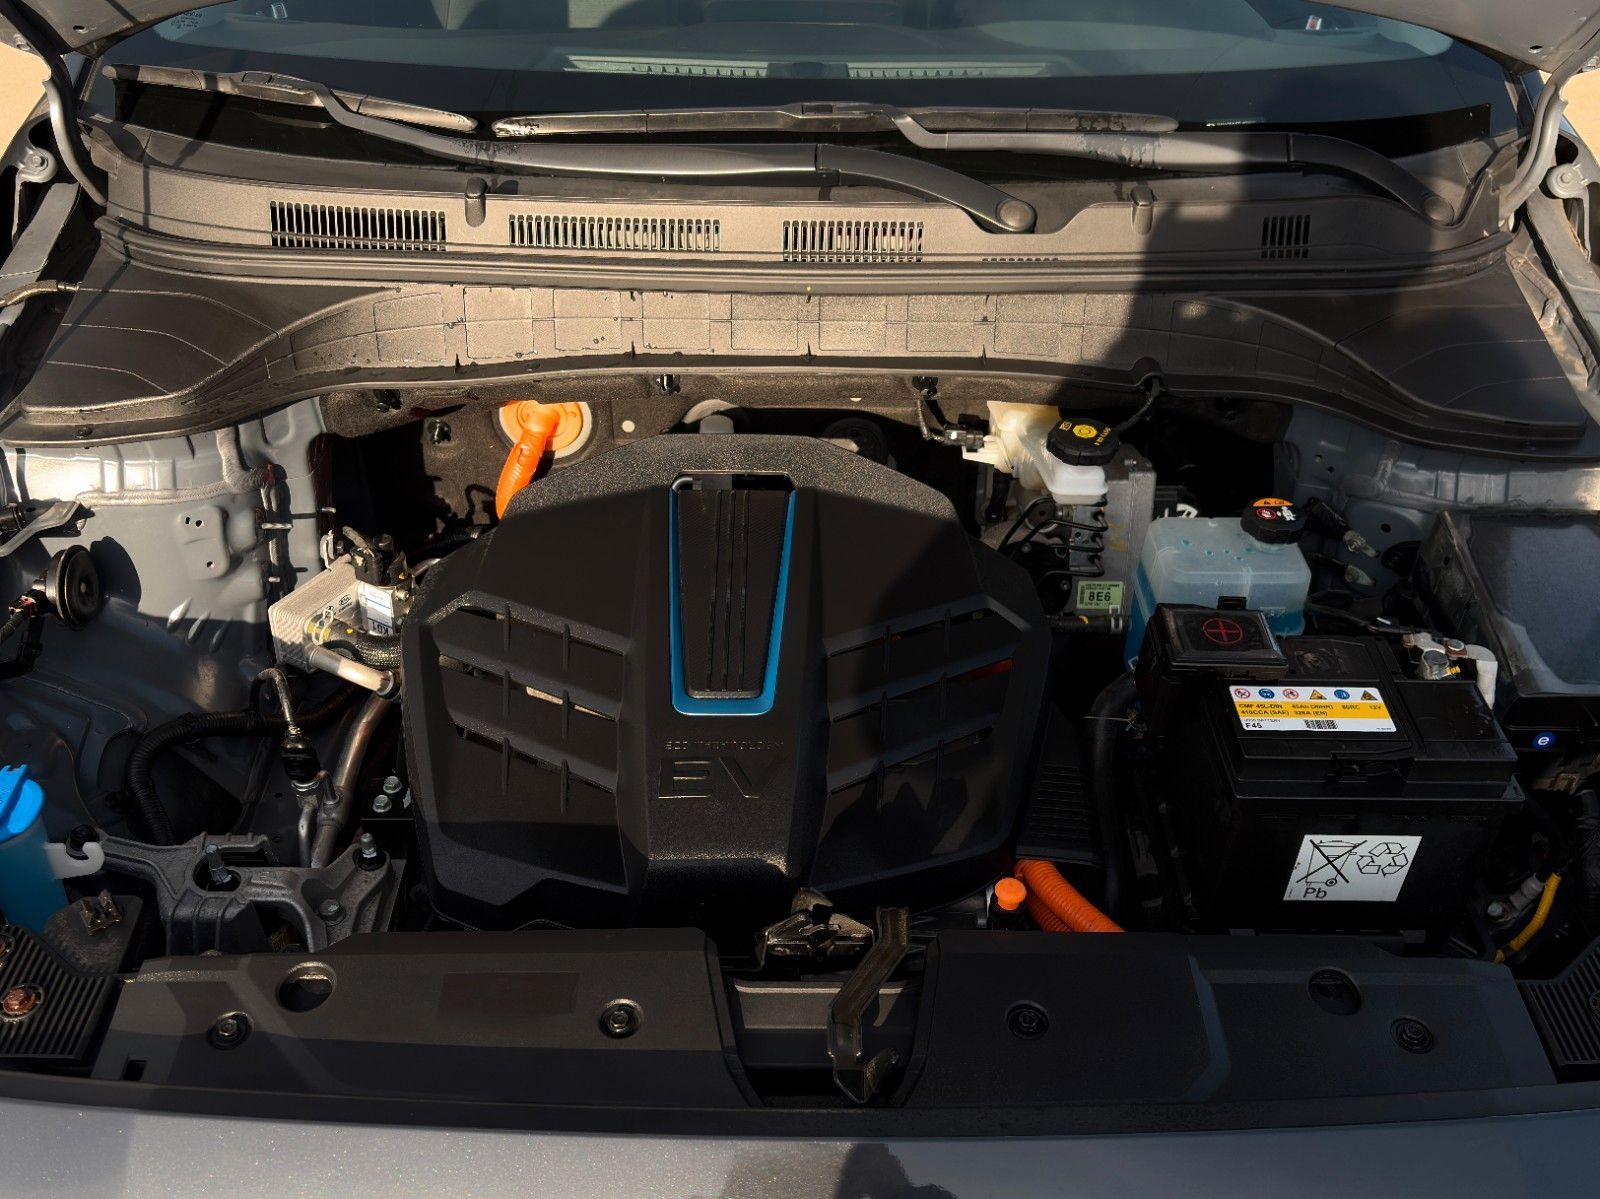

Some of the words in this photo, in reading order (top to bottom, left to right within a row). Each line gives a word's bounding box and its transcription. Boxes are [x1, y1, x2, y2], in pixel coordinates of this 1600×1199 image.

[1089, 591, 1111, 601] 8E6
[658, 758, 783, 798] EV
[1303, 887, 1328, 899] Pb
